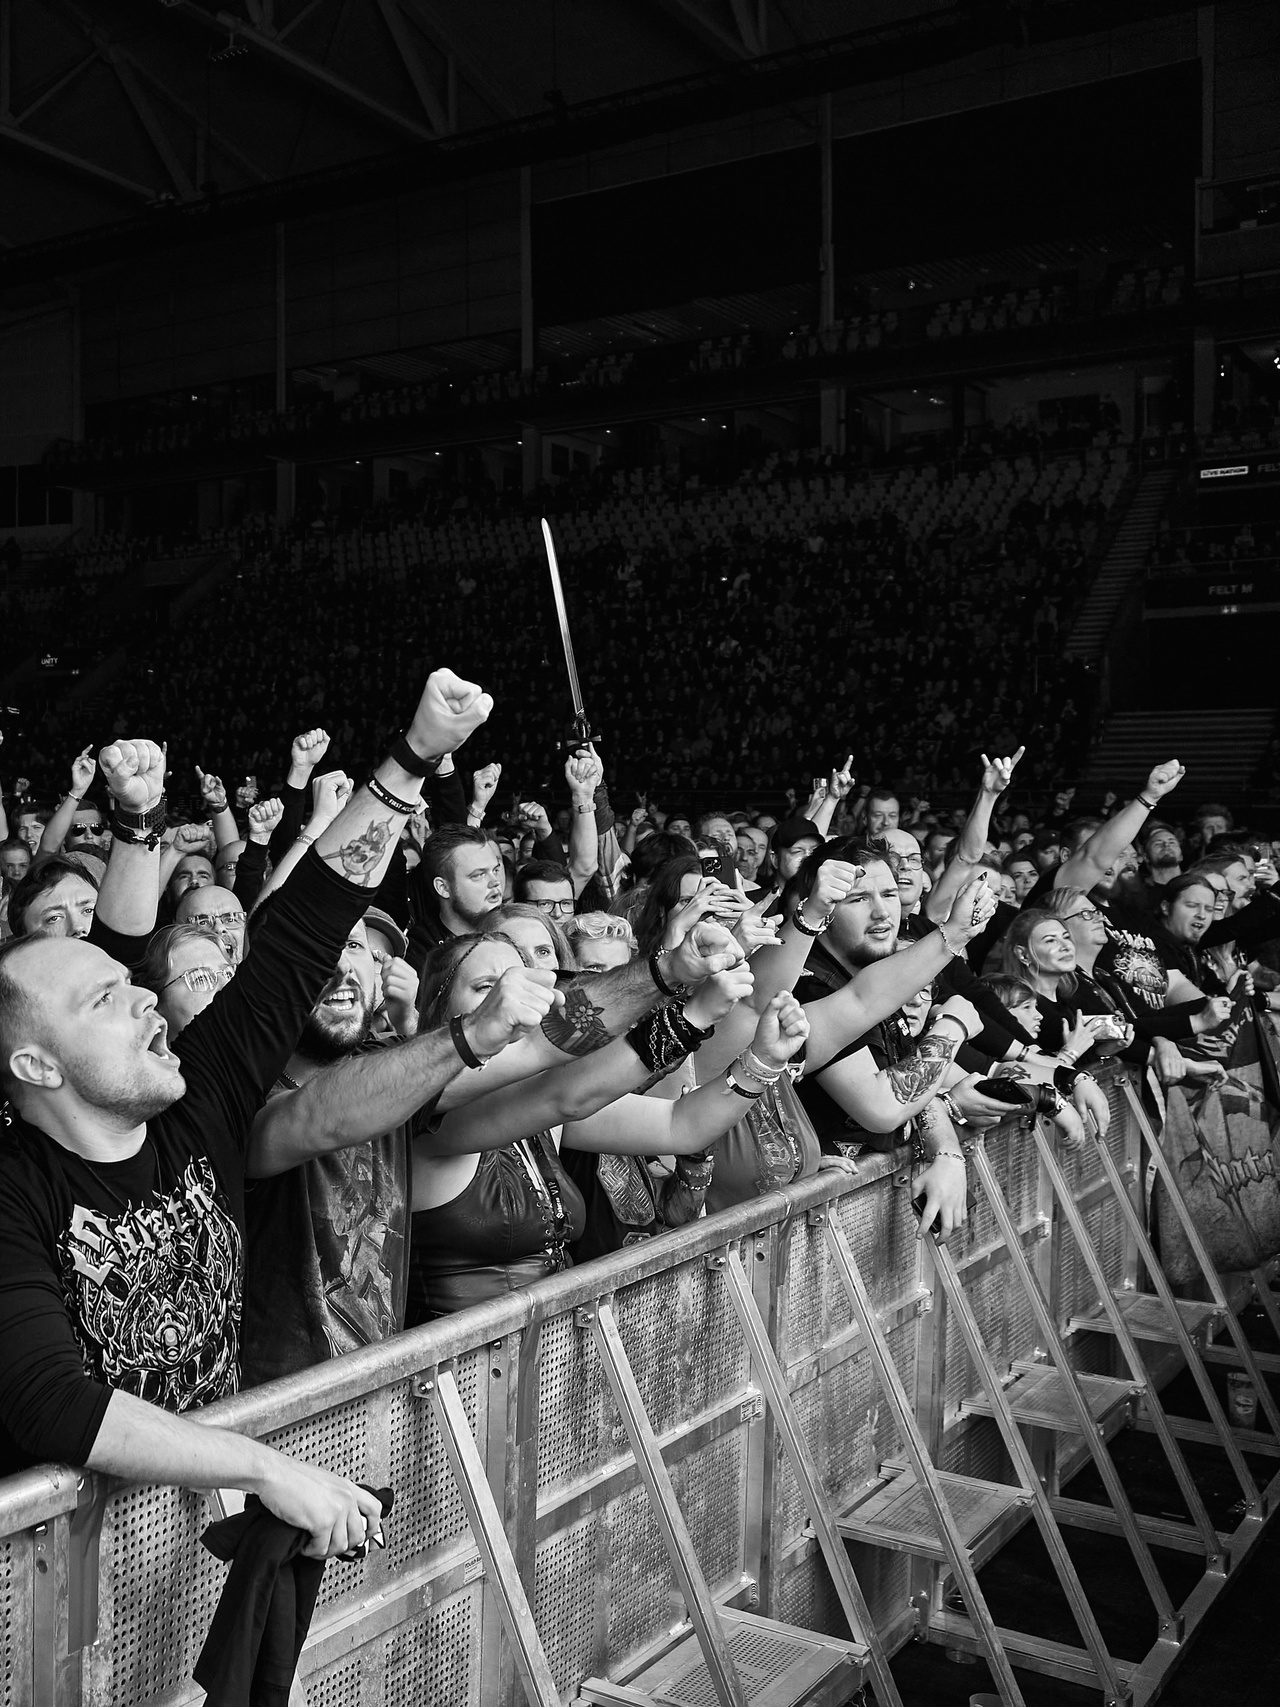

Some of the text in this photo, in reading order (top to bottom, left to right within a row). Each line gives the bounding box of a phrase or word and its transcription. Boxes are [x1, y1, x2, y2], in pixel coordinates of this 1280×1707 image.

[1207, 584, 1240, 596] FELT
[40, 657, 59, 665] UNITY
[547, 1181, 560, 1197] VIP
